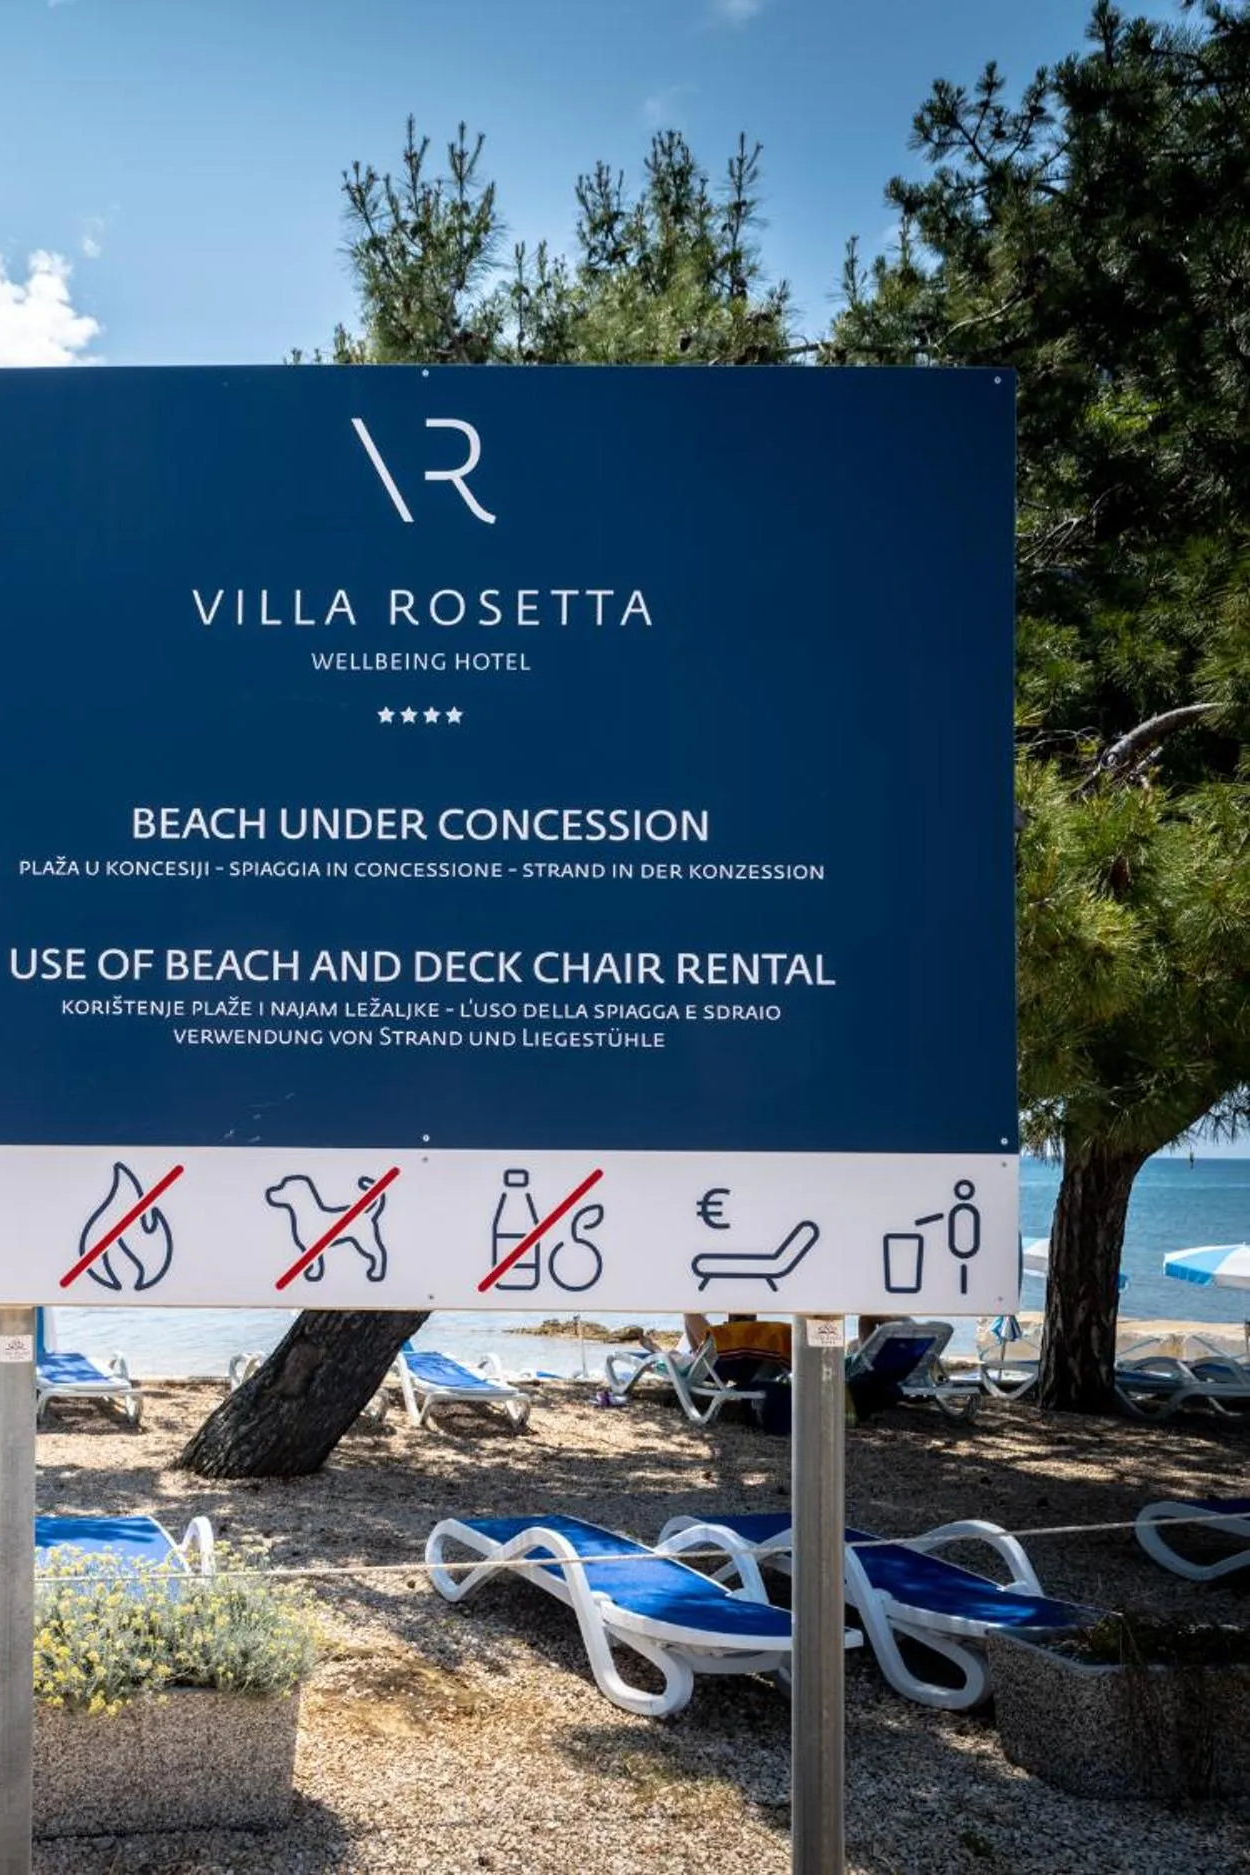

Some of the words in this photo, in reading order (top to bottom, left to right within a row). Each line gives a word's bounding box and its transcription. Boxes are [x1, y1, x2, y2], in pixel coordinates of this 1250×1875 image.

[191, 588, 357, 627] VILLA
[389, 588, 653, 627] ROSETTA
[310, 651, 447, 672] WELLBEING
[454, 651, 532, 672] HOTEL
[132, 806, 267, 841] BEACH
[279, 806, 429, 841] UNDER
[437, 807, 709, 843] CONCESSION
[18, 854, 81, 877] PLAŽA
[84, 859, 101, 877] U
[105, 859, 210, 881] KONCESIJI
[228, 860, 322, 878] SPIAGGIA
[325, 861, 349, 878] IN
[353, 861, 504, 879] CONCESSIONE
[521, 861, 607, 880] STRAND
[611, 862, 634, 880] IN
[640, 862, 684, 880] DER
[688, 863, 825, 881] KONZESSION
[9, 946, 88, 981] USE
[96, 947, 156, 982] OF
[165, 948, 300, 983] BEACH
[308, 949, 402, 984] AND
[413, 949, 524, 984] DECK
[532, 950, 666, 985] CHAIR
[676, 951, 837, 987] RENTAL
[61, 994, 186, 1019] KORIŠTENJE
[191, 994, 253, 1017] PLAŽE
[269, 1000, 339, 1021] NAJAM
[344, 996, 440, 1022] LEŽALJKE
[522, 1002, 590, 1020] DELLA
[593, 1003, 681, 1021] SPIAGGA
[684, 1003, 698, 1021] E
[702, 1003, 782, 1022] SDRAIO
[172, 1027, 324, 1046] VERWENDUNG
[328, 1029, 374, 1047] VON
[468, 1030, 517, 1048] UND
